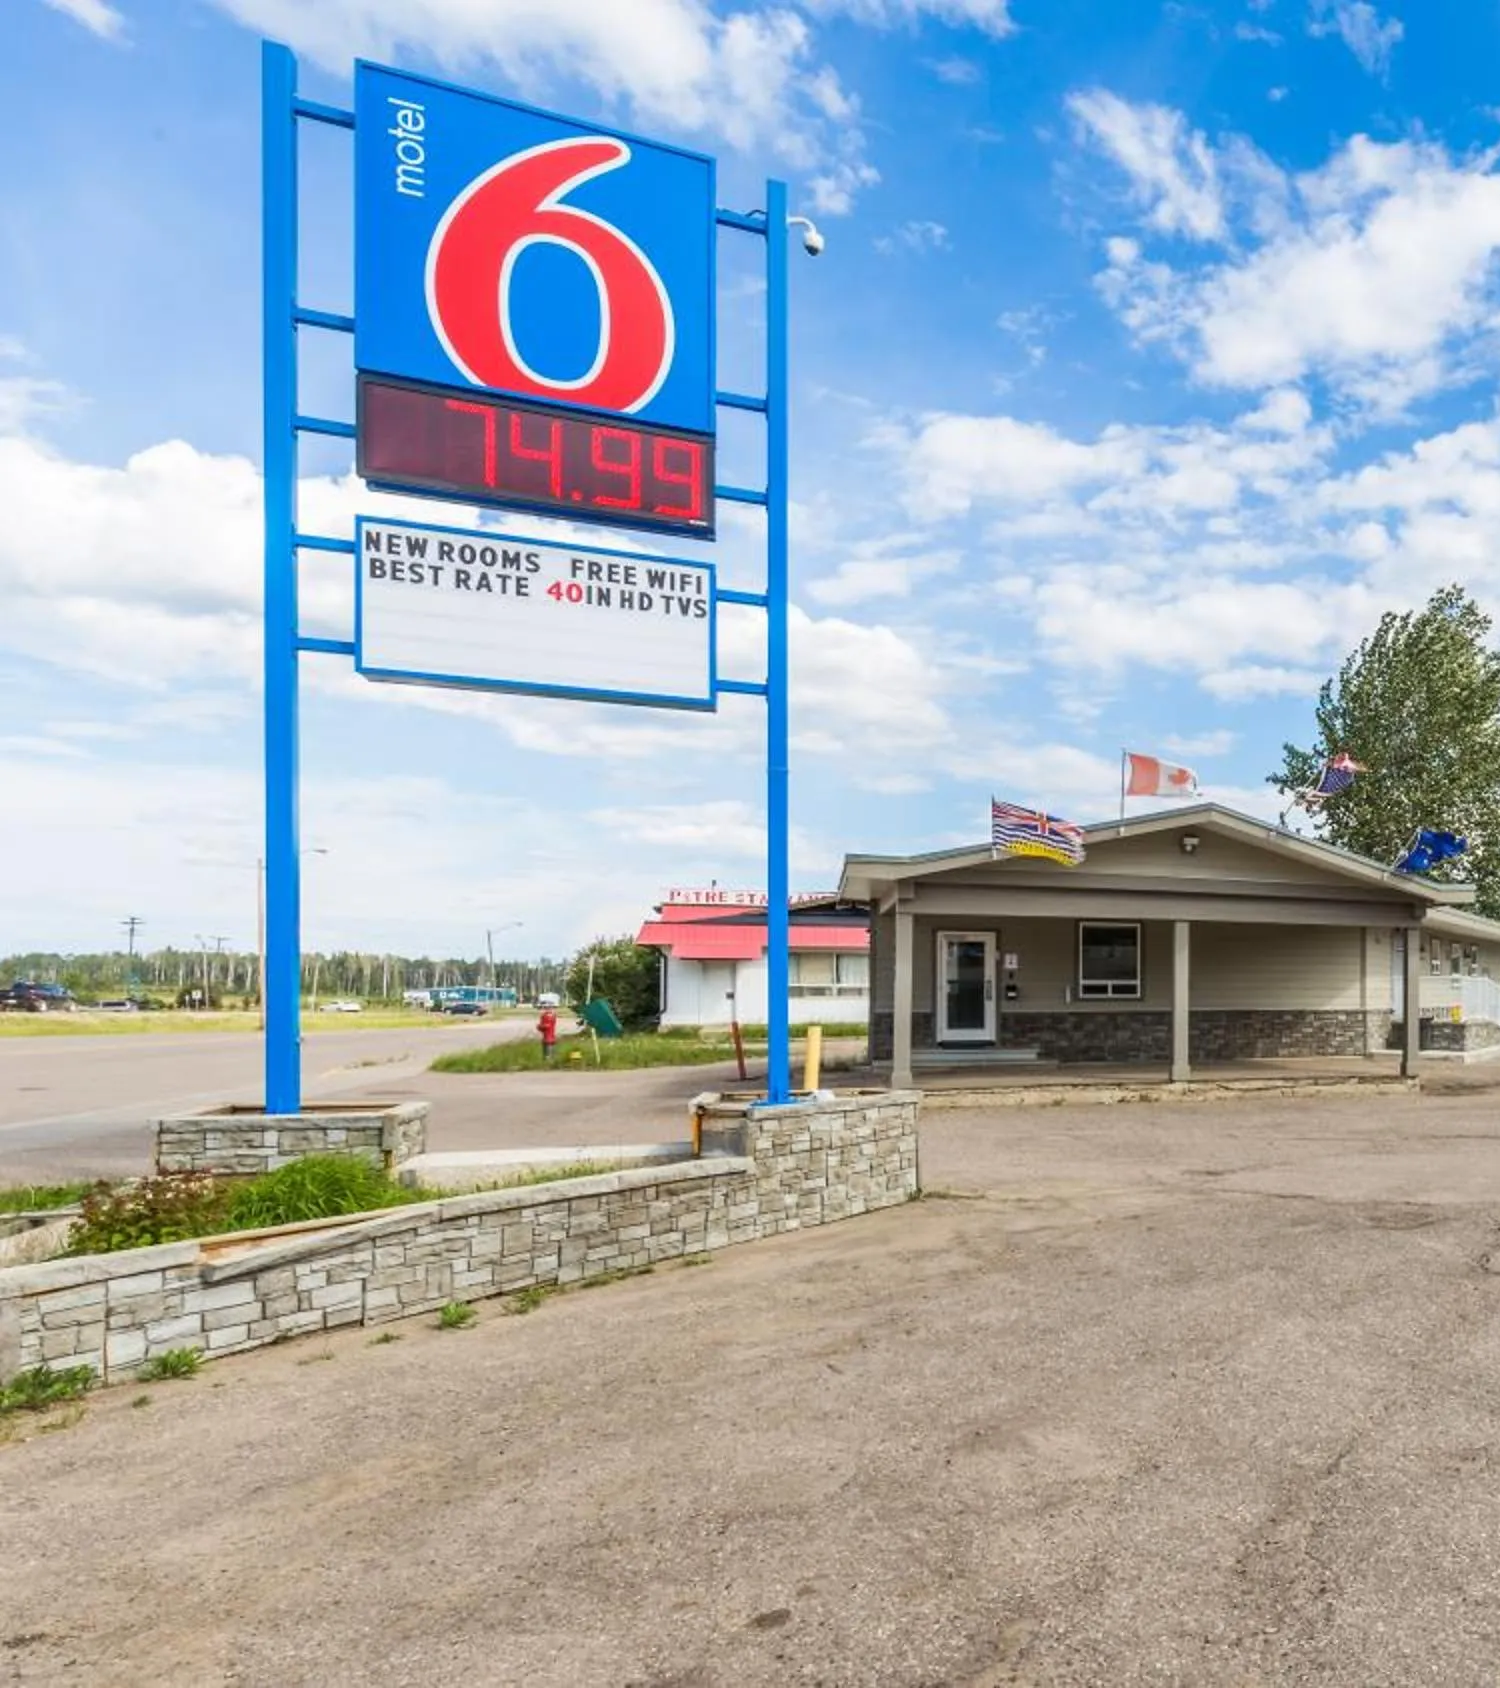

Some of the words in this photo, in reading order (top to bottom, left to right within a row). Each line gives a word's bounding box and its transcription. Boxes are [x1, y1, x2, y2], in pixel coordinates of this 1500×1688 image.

[387, 97, 425, 198] motel
[424, 135, 675, 413] 6
[446, 399, 701, 518] 74.99
[365, 530, 429, 559] NEW
[438, 540, 541, 573] ROOMS
[571, 558, 637, 586] FREE
[646, 568, 702, 595] WIFI
[369, 557, 445, 587] BEST
[455, 568, 529, 597] RATE
[620, 589, 653, 611] HD
[660, 594, 708, 619] TVS
